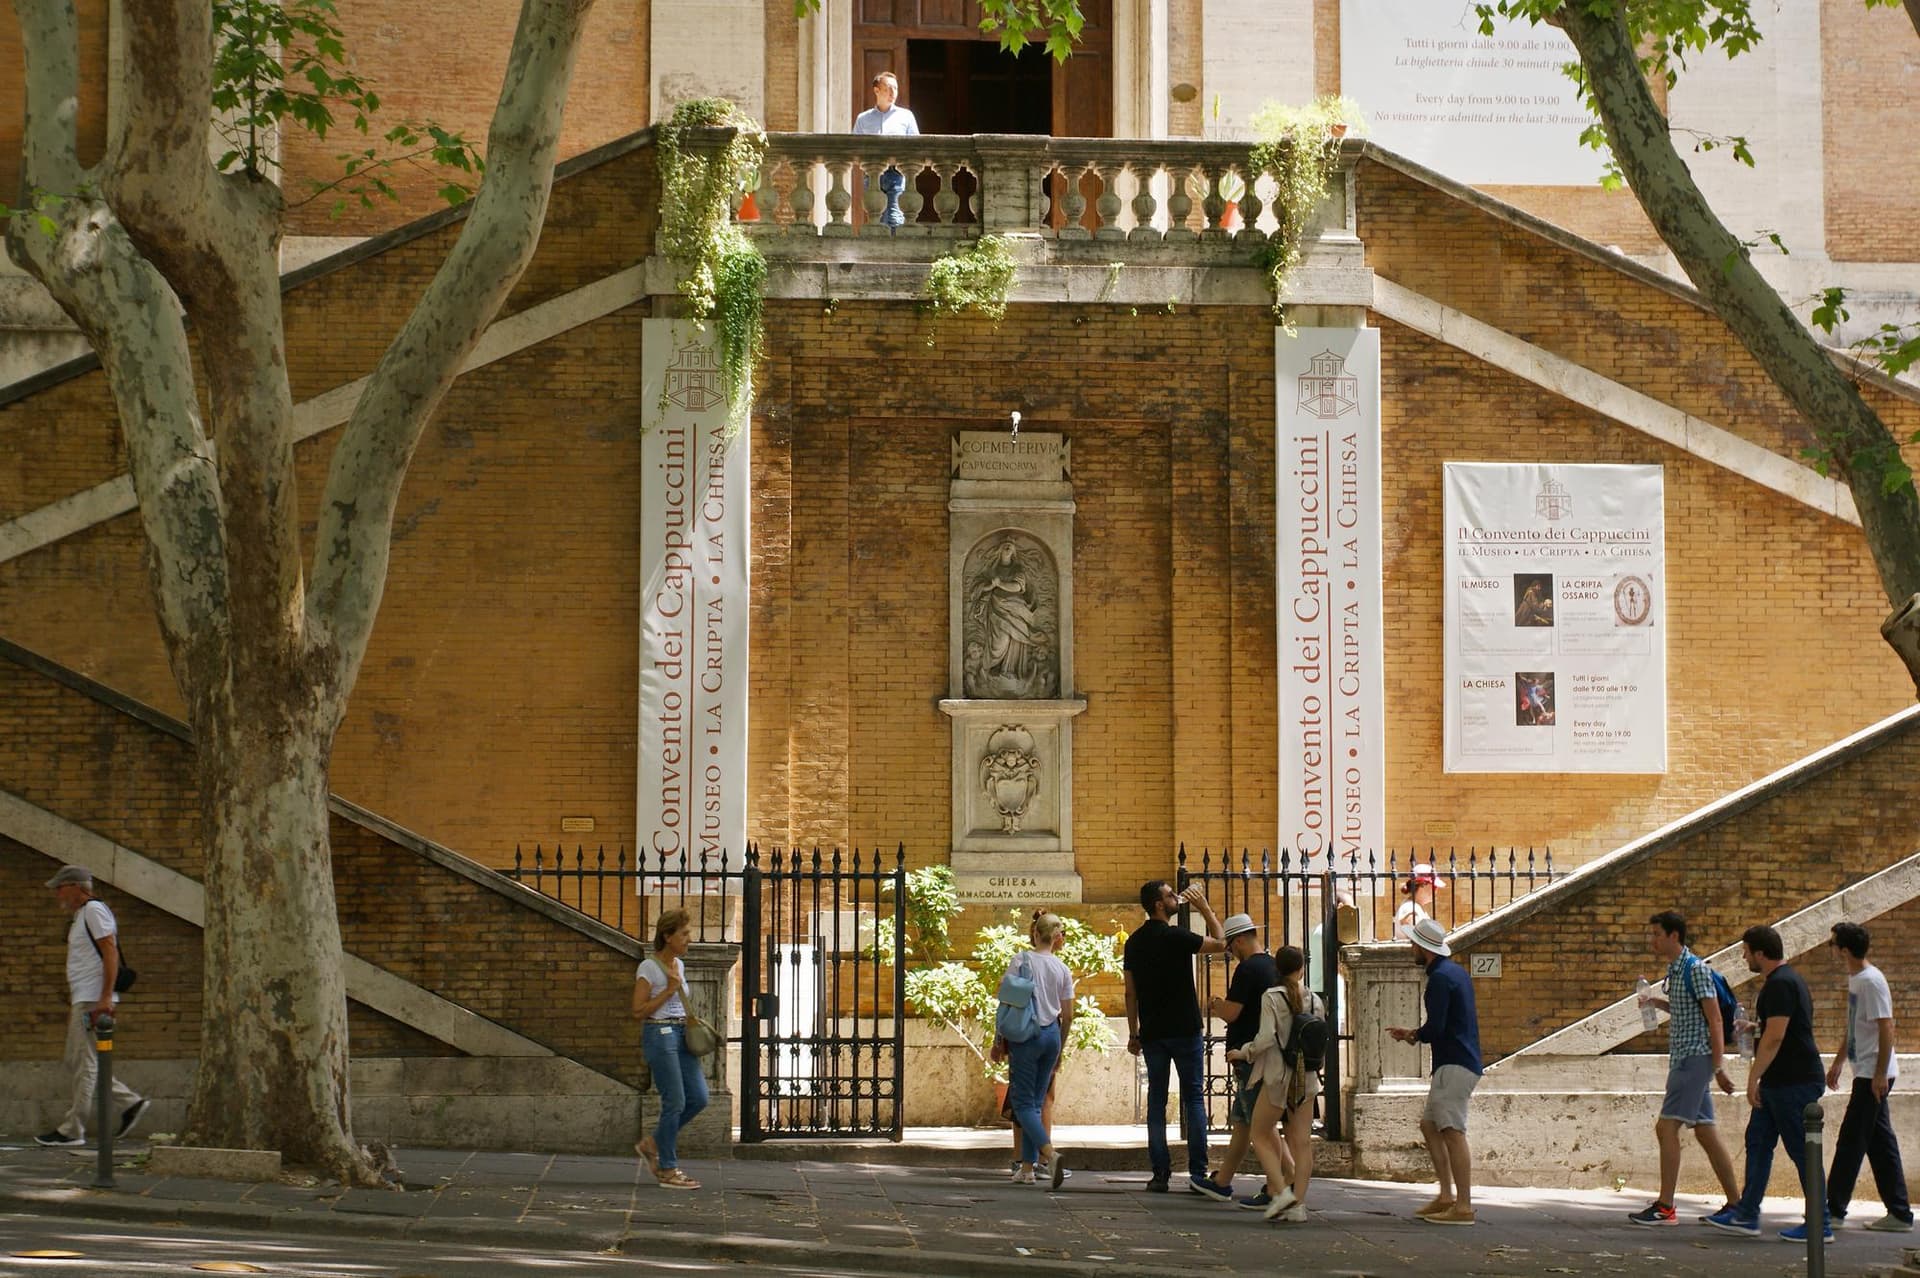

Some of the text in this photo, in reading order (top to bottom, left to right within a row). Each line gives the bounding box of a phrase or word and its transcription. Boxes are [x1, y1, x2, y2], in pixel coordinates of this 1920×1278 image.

[1406, 38, 1428, 49] Tutti
[1438, 39, 1468, 51] giorni
[1471, 38, 1495, 49] dalle
[1498, 39, 1519, 49] 9.00
[1522, 39, 1540, 50] alle
[1544, 39, 1570, 50] 19.00
[1394, 56, 1407, 66] La
[1410, 56, 1463, 70] biglietteria
[1466, 57, 1500, 67] chiude
[1503, 59, 1514, 68] 30
[1517, 59, 1550, 69] minuti
[1416, 93, 1560, 105] Every day from 9.00 to 19.00
[1374, 111, 1389, 121] No
[1392, 112, 1427, 121] visitors
[1430, 114, 1446, 122] are
[1448, 112, 1493, 123] admitted
[1496, 114, 1505, 123] in
[1508, 112, 1522, 123] the
[1526, 113, 1543, 124] last
[1546, 114, 1559, 124] 30
[703, 424, 726, 523] CHIESA
[1337, 432, 1358, 528] CHIESA
[656, 427, 692, 618] Cappuccini
[1294, 434, 1328, 623] Cappuccini
[1458, 527, 1649, 543] Il Convento dei Cappuccini
[708, 533, 724, 563] LA
[1343, 538, 1358, 569] LA
[1472, 546, 1511, 556] MUSEO
[1523, 548, 1536, 556] LA
[1540, 546, 1580, 556] CRIPTA
[1610, 546, 1651, 557] CHIESA
[1461, 580, 1500, 589] IL MUSEO
[1562, 580, 1602, 589] LA CRIPTA
[1562, 591, 1599, 600] OSSARIO
[655, 630, 683, 680] dei
[701, 596, 723, 693] CRIPTA
[1293, 634, 1321, 684] dei
[1339, 601, 1360, 697] CRIPTA
[1463, 680, 1506, 688] LA CHIESA
[706, 703, 722, 735] LA
[1345, 706, 1360, 737] LA
[1573, 720, 1606, 729] Every day
[653, 691, 682, 857] Convento
[1296, 695, 1323, 858] Convento
[700, 765, 721, 859] MUSEO
[1341, 767, 1361, 860] MUSEO
[989, 877, 1037, 887] CHIESA
[1017, 891, 1072, 899] CONCEZIONE
[1477, 958, 1495, 973] 27
